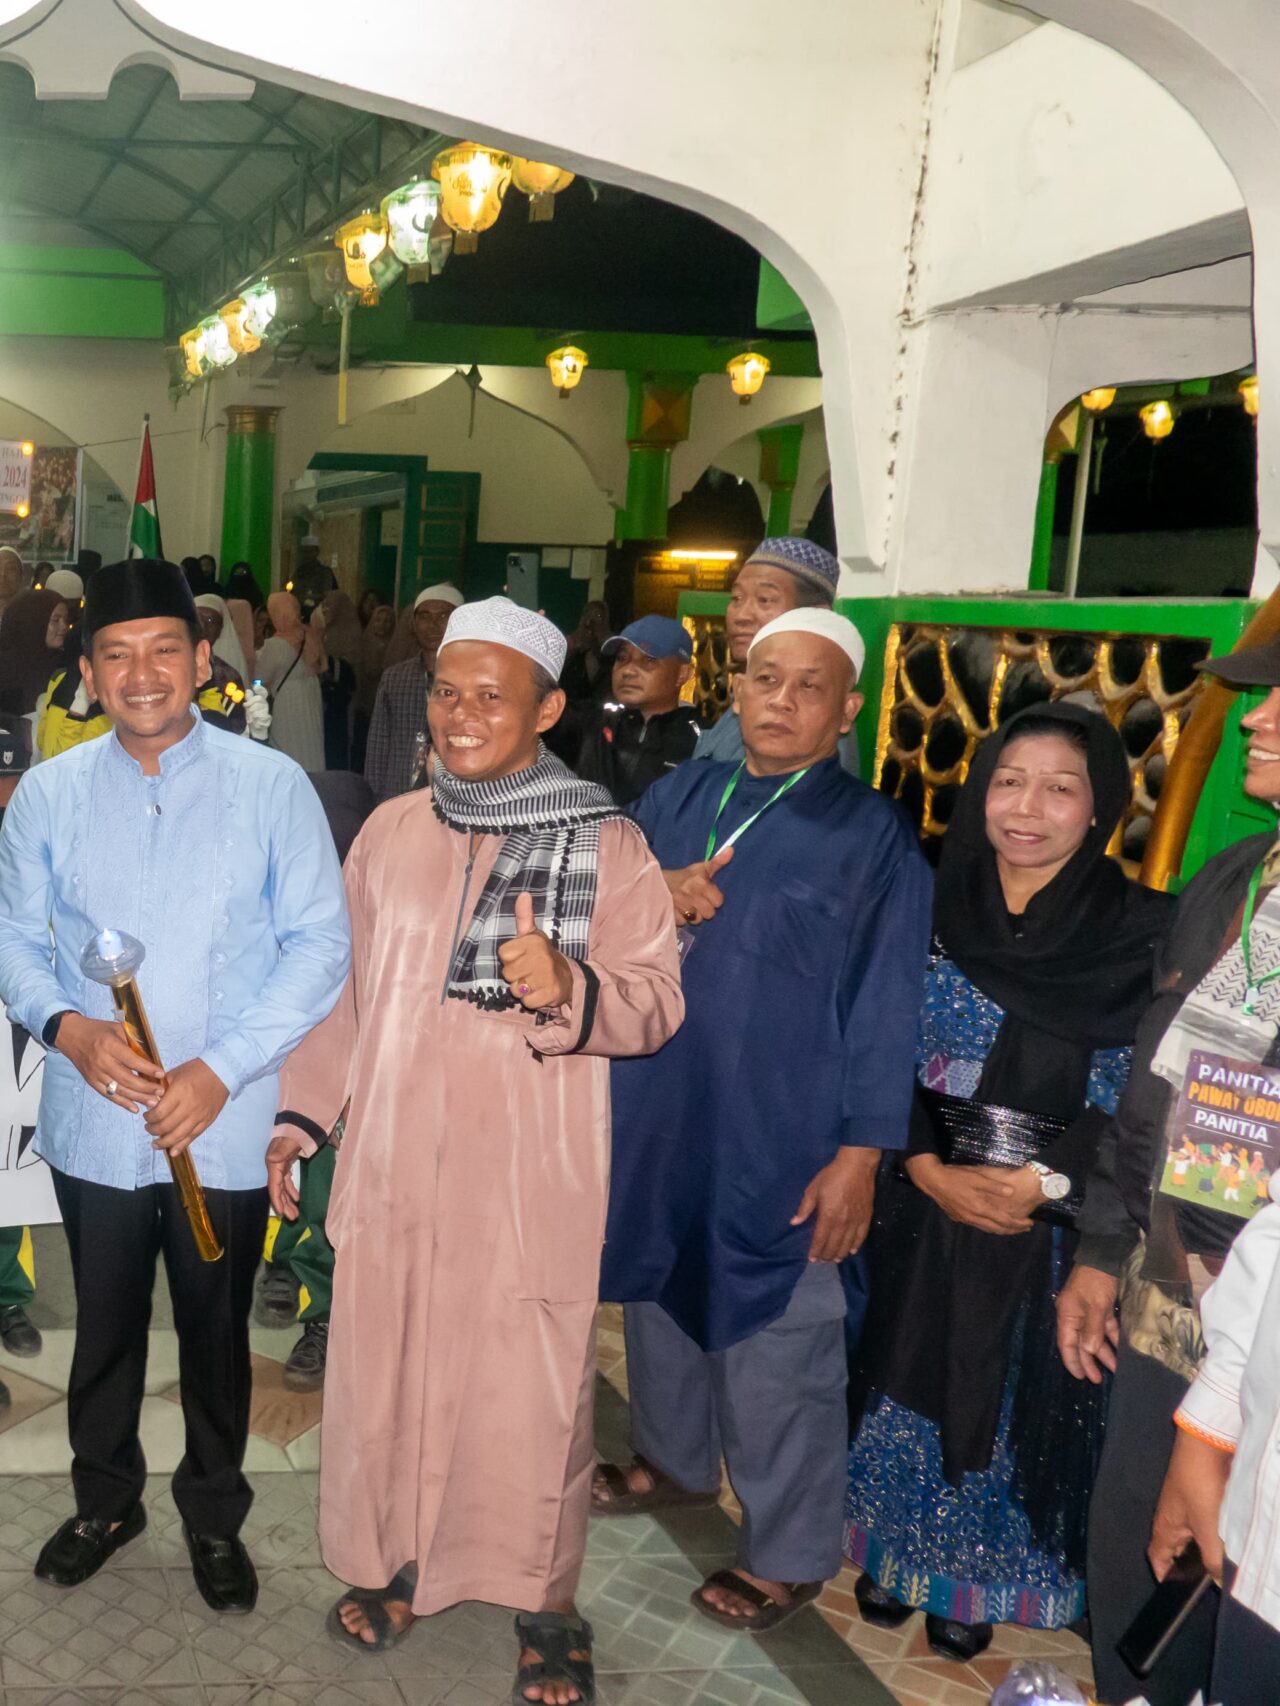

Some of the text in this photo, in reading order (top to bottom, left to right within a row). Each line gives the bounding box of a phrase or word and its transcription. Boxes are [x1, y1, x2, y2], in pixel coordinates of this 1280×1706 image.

[3, 466, 28, 488] 2024
[1198, 1063, 1280, 1099] PANITIA
[1195, 1109, 1268, 1142] PANITIA
